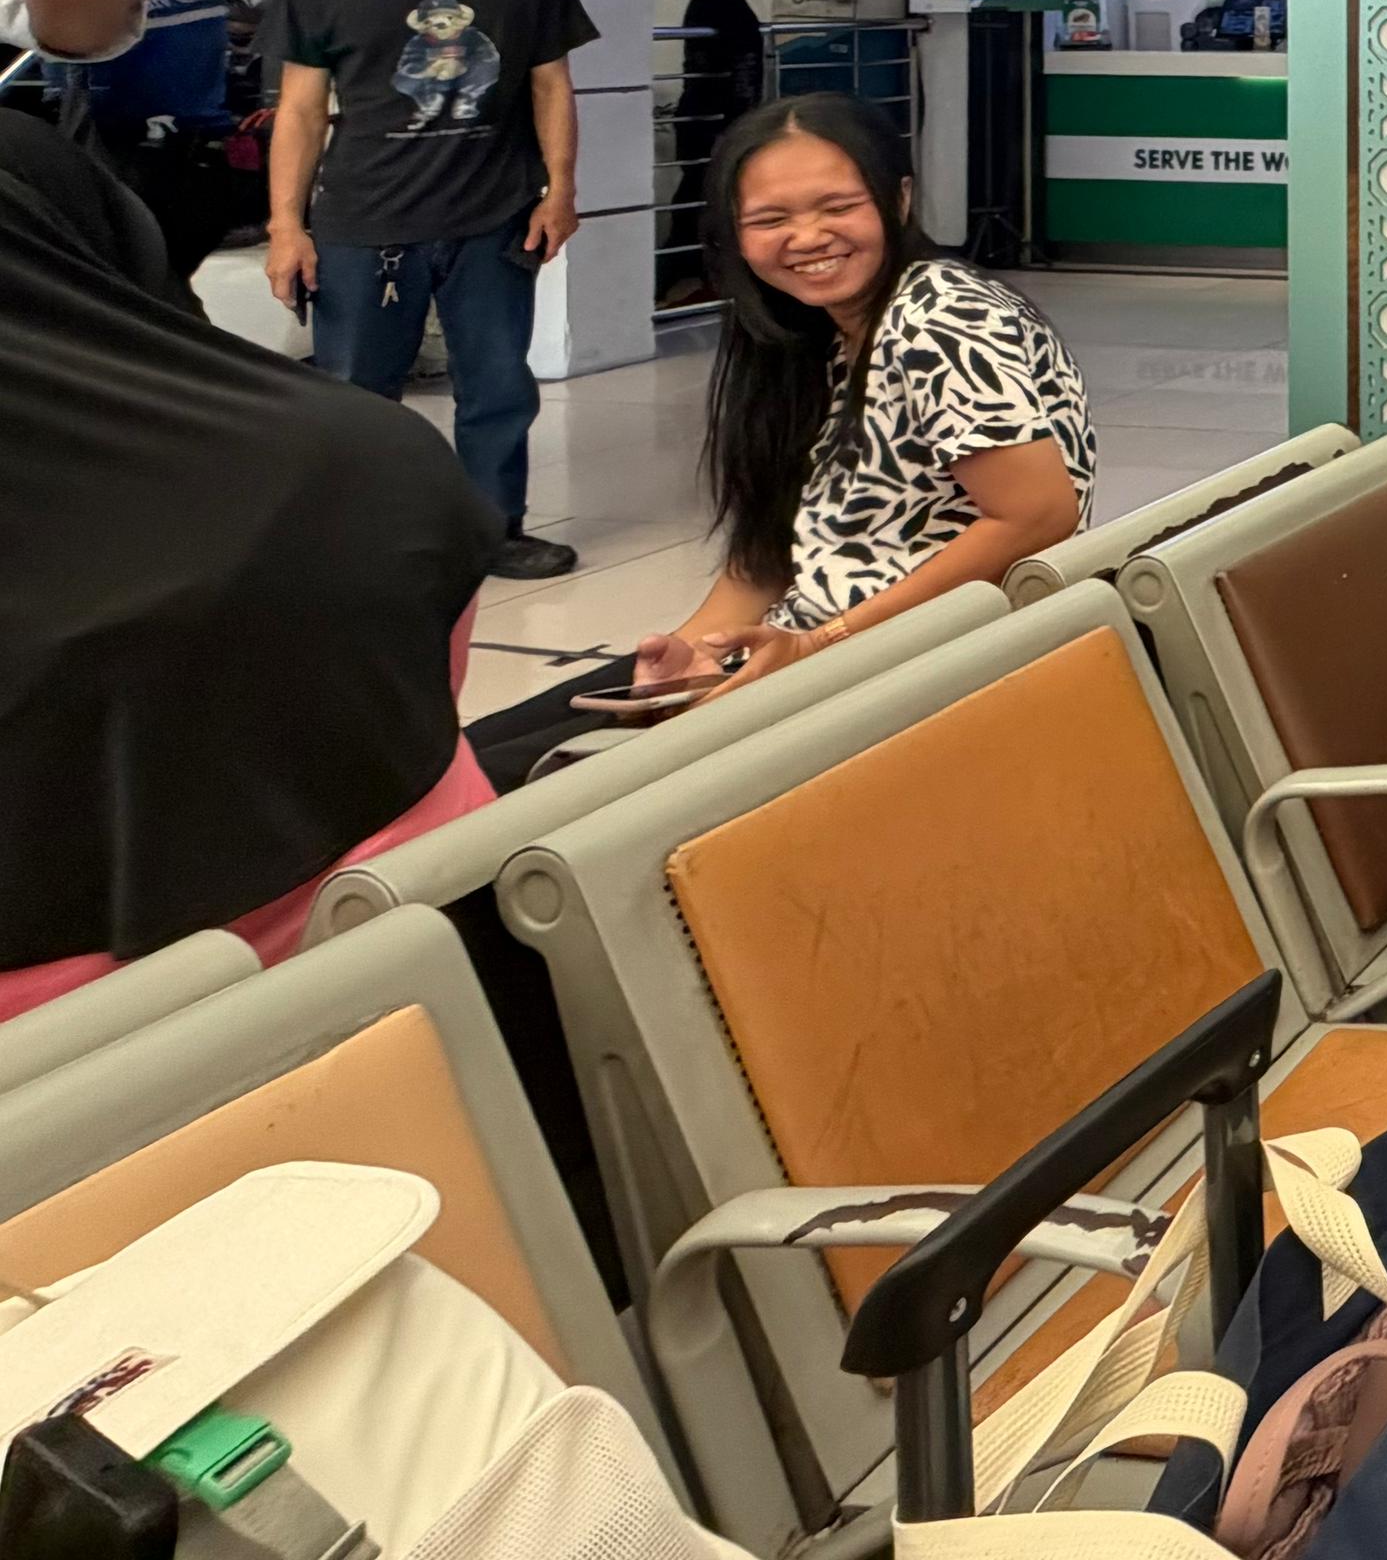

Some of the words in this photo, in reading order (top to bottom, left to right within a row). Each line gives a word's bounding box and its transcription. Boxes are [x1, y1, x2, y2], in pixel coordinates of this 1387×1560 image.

[1133, 148, 1204, 171] SERVE
[1210, 150, 1254, 172] THE
[1262, 152, 1288, 172] W
